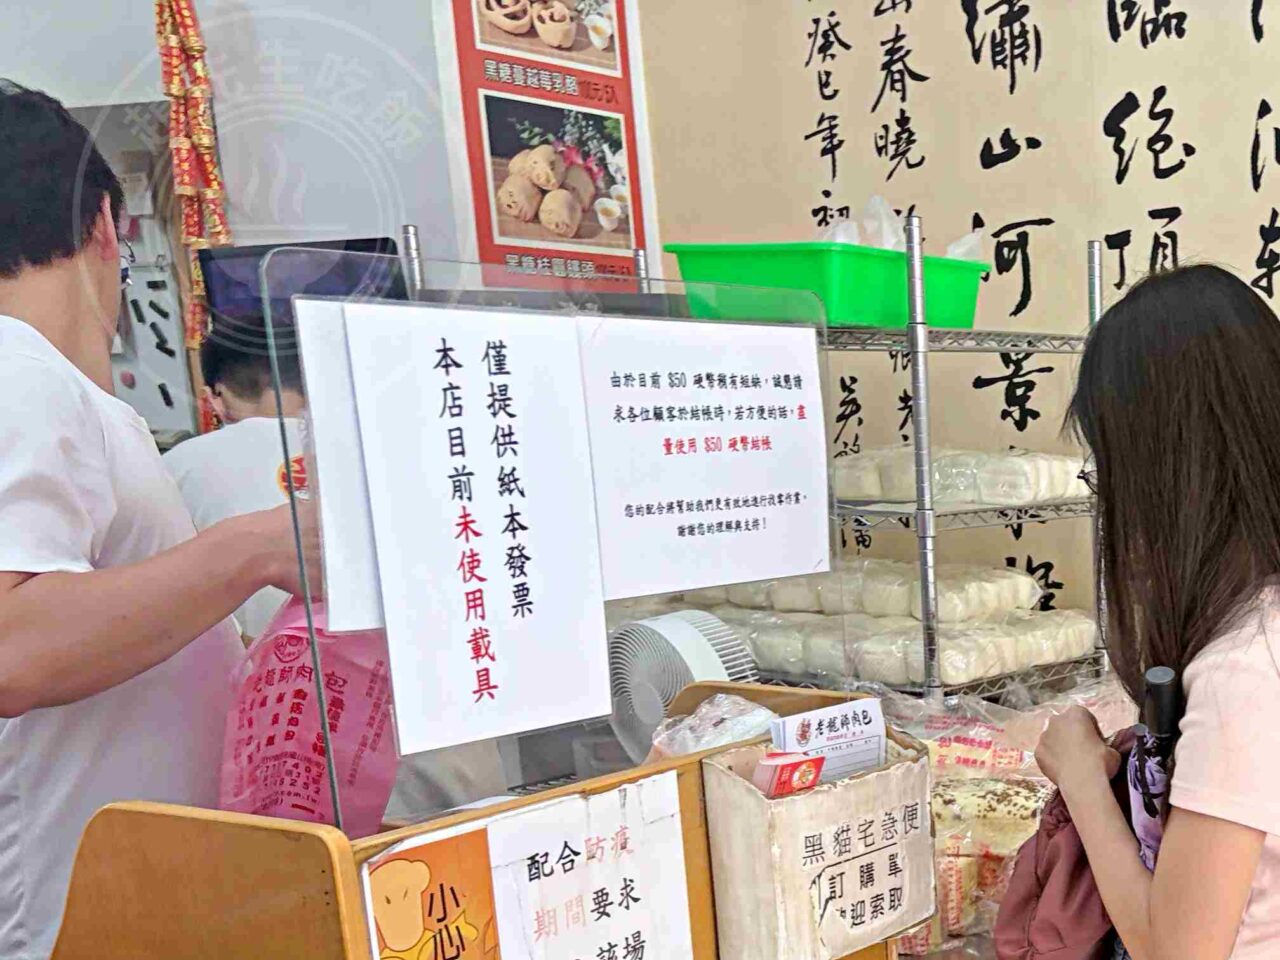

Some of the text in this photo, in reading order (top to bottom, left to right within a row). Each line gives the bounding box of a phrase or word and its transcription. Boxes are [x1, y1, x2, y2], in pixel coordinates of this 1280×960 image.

[610, 371, 661, 389] 由於目前
[481, 339, 534, 619] 僅提供紙本發票
[527, 825, 635, 881] 配合防疫
[802, 802, 920, 867] 黑貓宅急便
[533, 878, 641, 944] 期間要求
